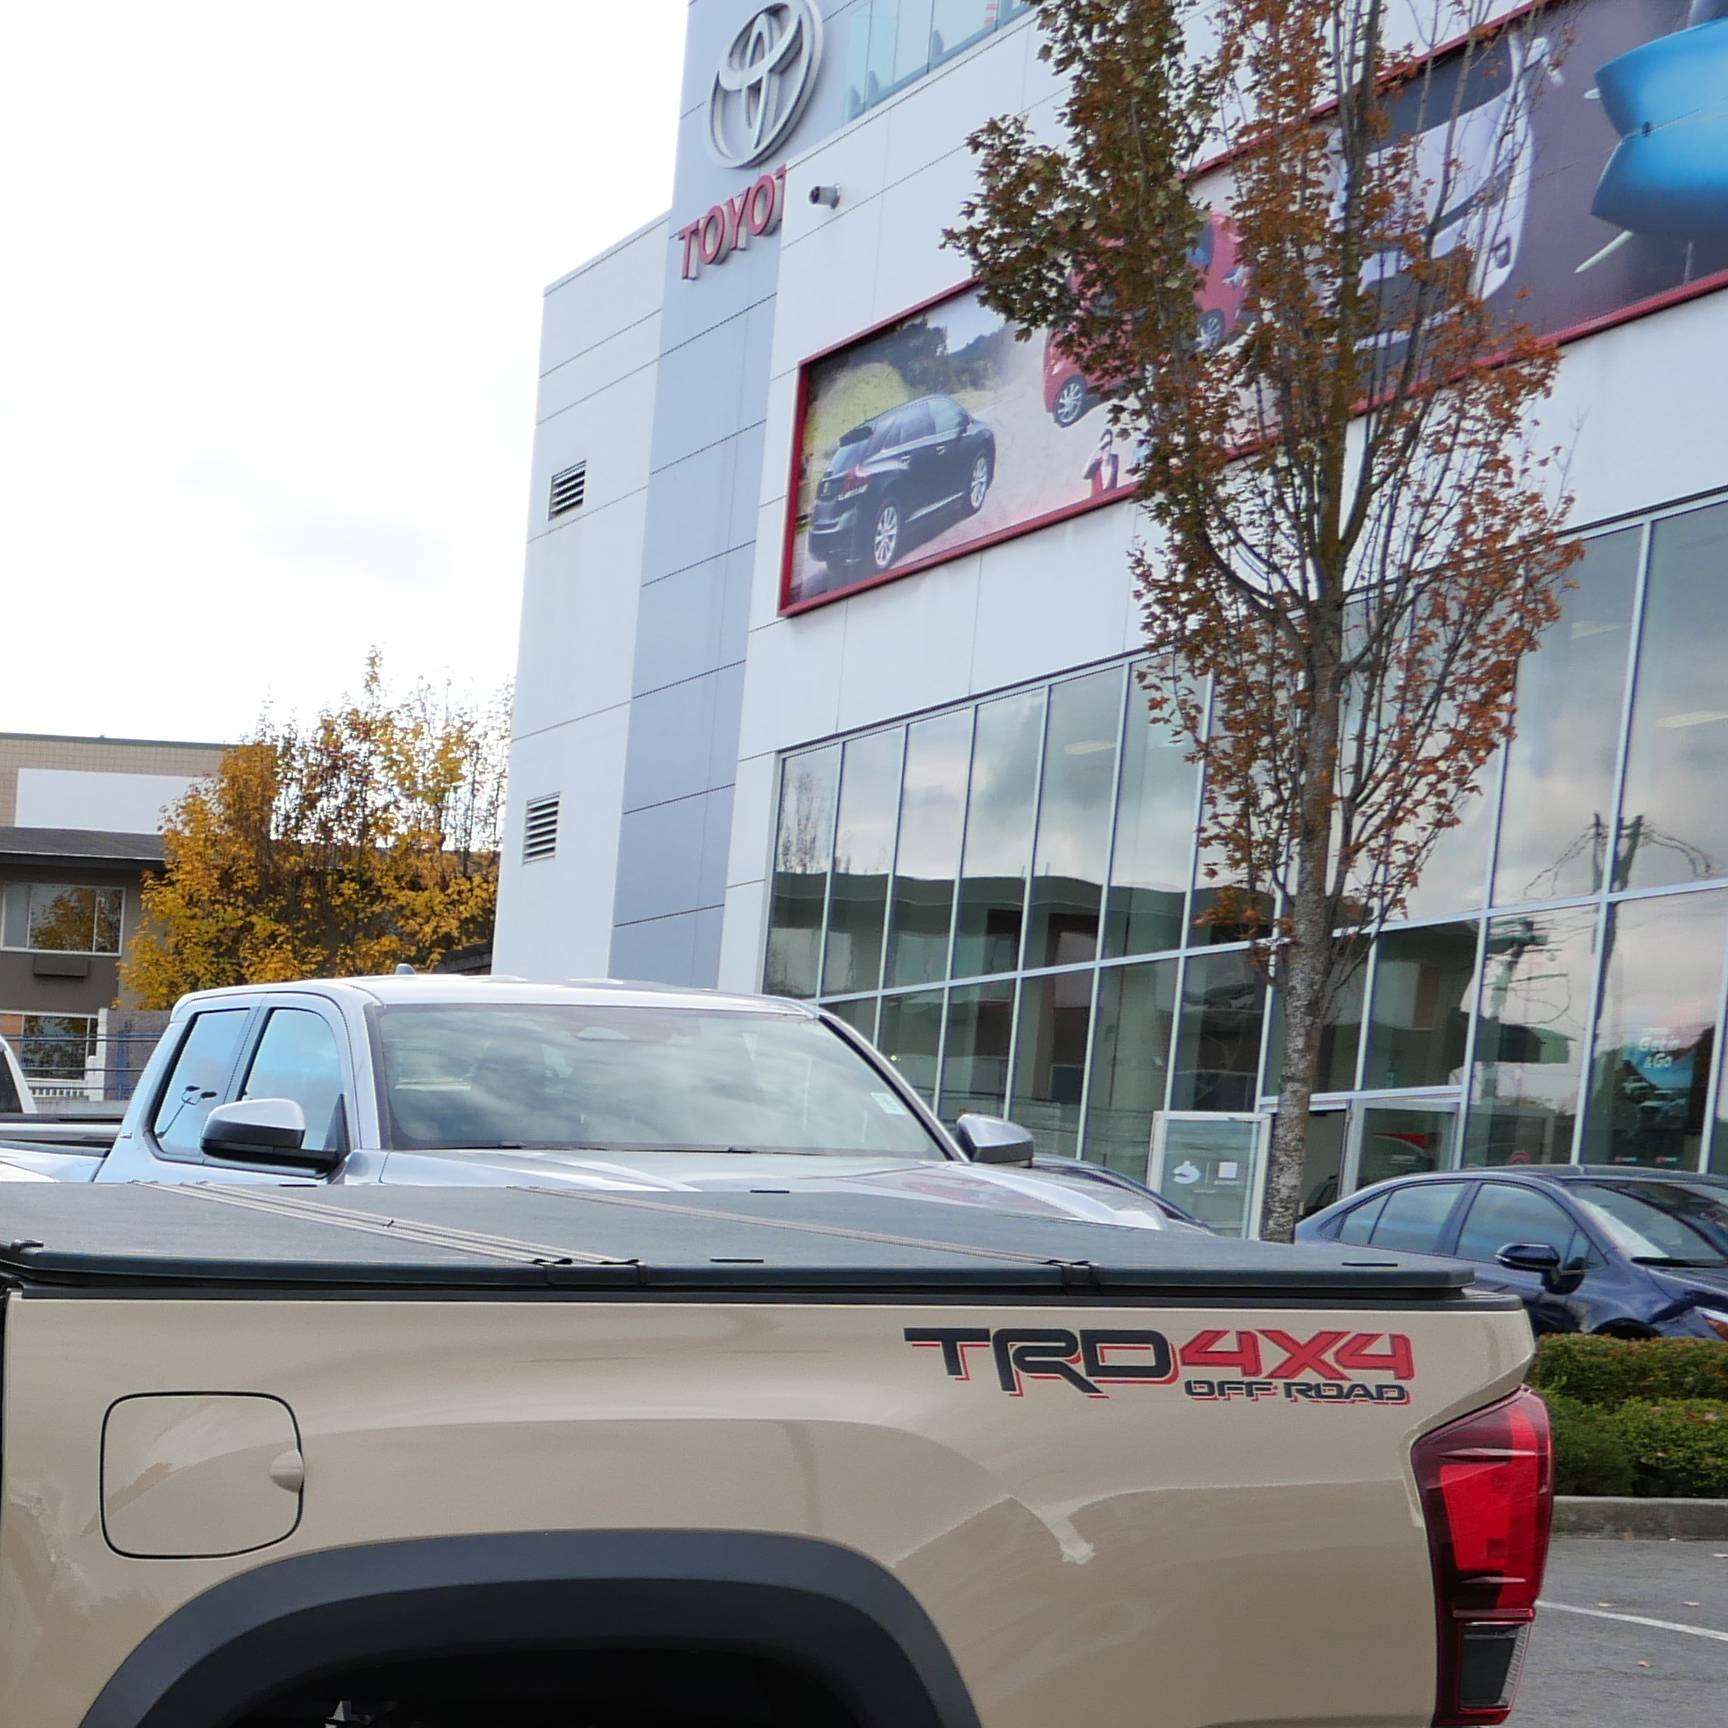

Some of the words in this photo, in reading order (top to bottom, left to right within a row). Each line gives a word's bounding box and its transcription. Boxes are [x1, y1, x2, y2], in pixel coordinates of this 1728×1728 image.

[904, 1327, 1178, 1399] TRD
[1185, 1379, 1276, 1403] OFF
[1284, 1381, 1411, 1406] ROAD
